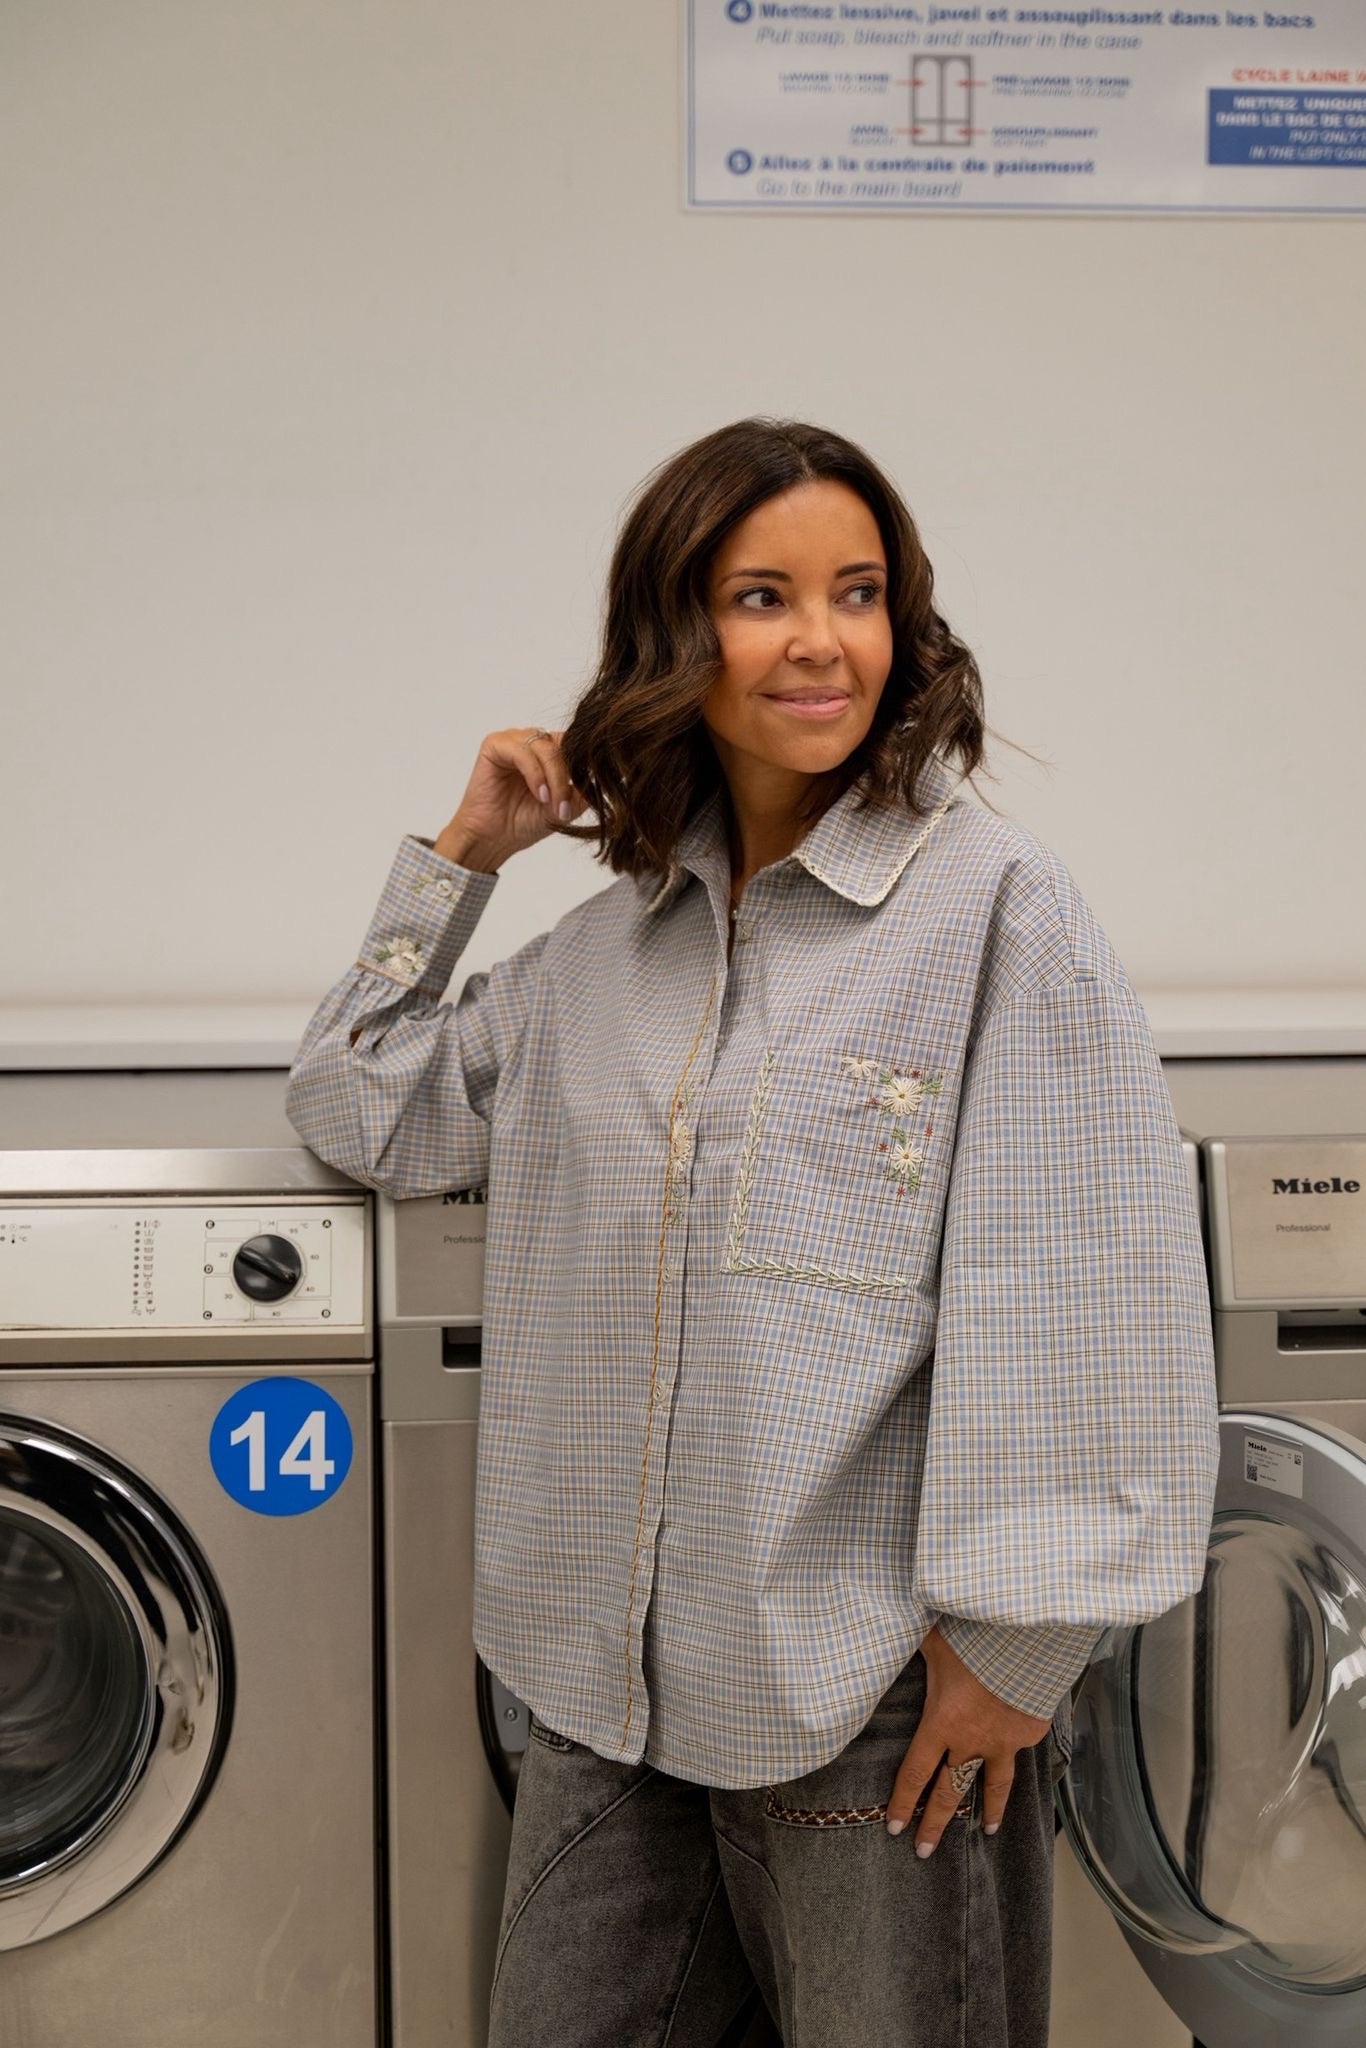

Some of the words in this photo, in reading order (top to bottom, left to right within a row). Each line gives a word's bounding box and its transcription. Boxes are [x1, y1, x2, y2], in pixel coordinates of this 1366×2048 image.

[760, 3, 833, 21] Mettez
[841, 4, 921, 24] lessive,
[928, 5, 980, 26] javel
[986, 8, 1008, 23] et
[1015, 9, 1164, 28] assouplissant
[1169, 10, 1220, 27] dans
[1227, 11, 1257, 28] les
[1264, 12, 1316, 29] bacs
[757, 26, 791, 42] Put
[854, 27, 918, 45] bleach
[924, 29, 963, 46] and
[1037, 32, 1057, 48] in
[1060, 32, 1090, 49] the
[1095, 36, 1142, 50] case
[1233, 68, 1291, 82] CYCLE
[1296, 69, 1350, 84] LAINE
[1233, 96, 1298, 110] METTEZ
[1216, 112, 1260, 127] DANS
[1262, 112, 1283, 127] LE
[1285, 112, 1318, 127] BAC
[1320, 113, 1343, 127] DE
[761, 157, 811, 171] Allez
[836, 157, 856, 171] la
[865, 157, 954, 173] centrale
[962, 158, 985, 173] de
[994, 160, 1096, 177] paiement
[757, 182, 784, 197] Go
[815, 182, 844, 197] the
[852, 184, 897, 198] main
[904, 183, 963, 199] board
[1272, 1178, 1361, 1195] Miele
[443, 1188, 488, 1205] Mi
[1275, 1224, 1331, 1234] Professional
[229, 1411, 335, 1492] 14
[1248, 1442, 1267, 1452] Miele
